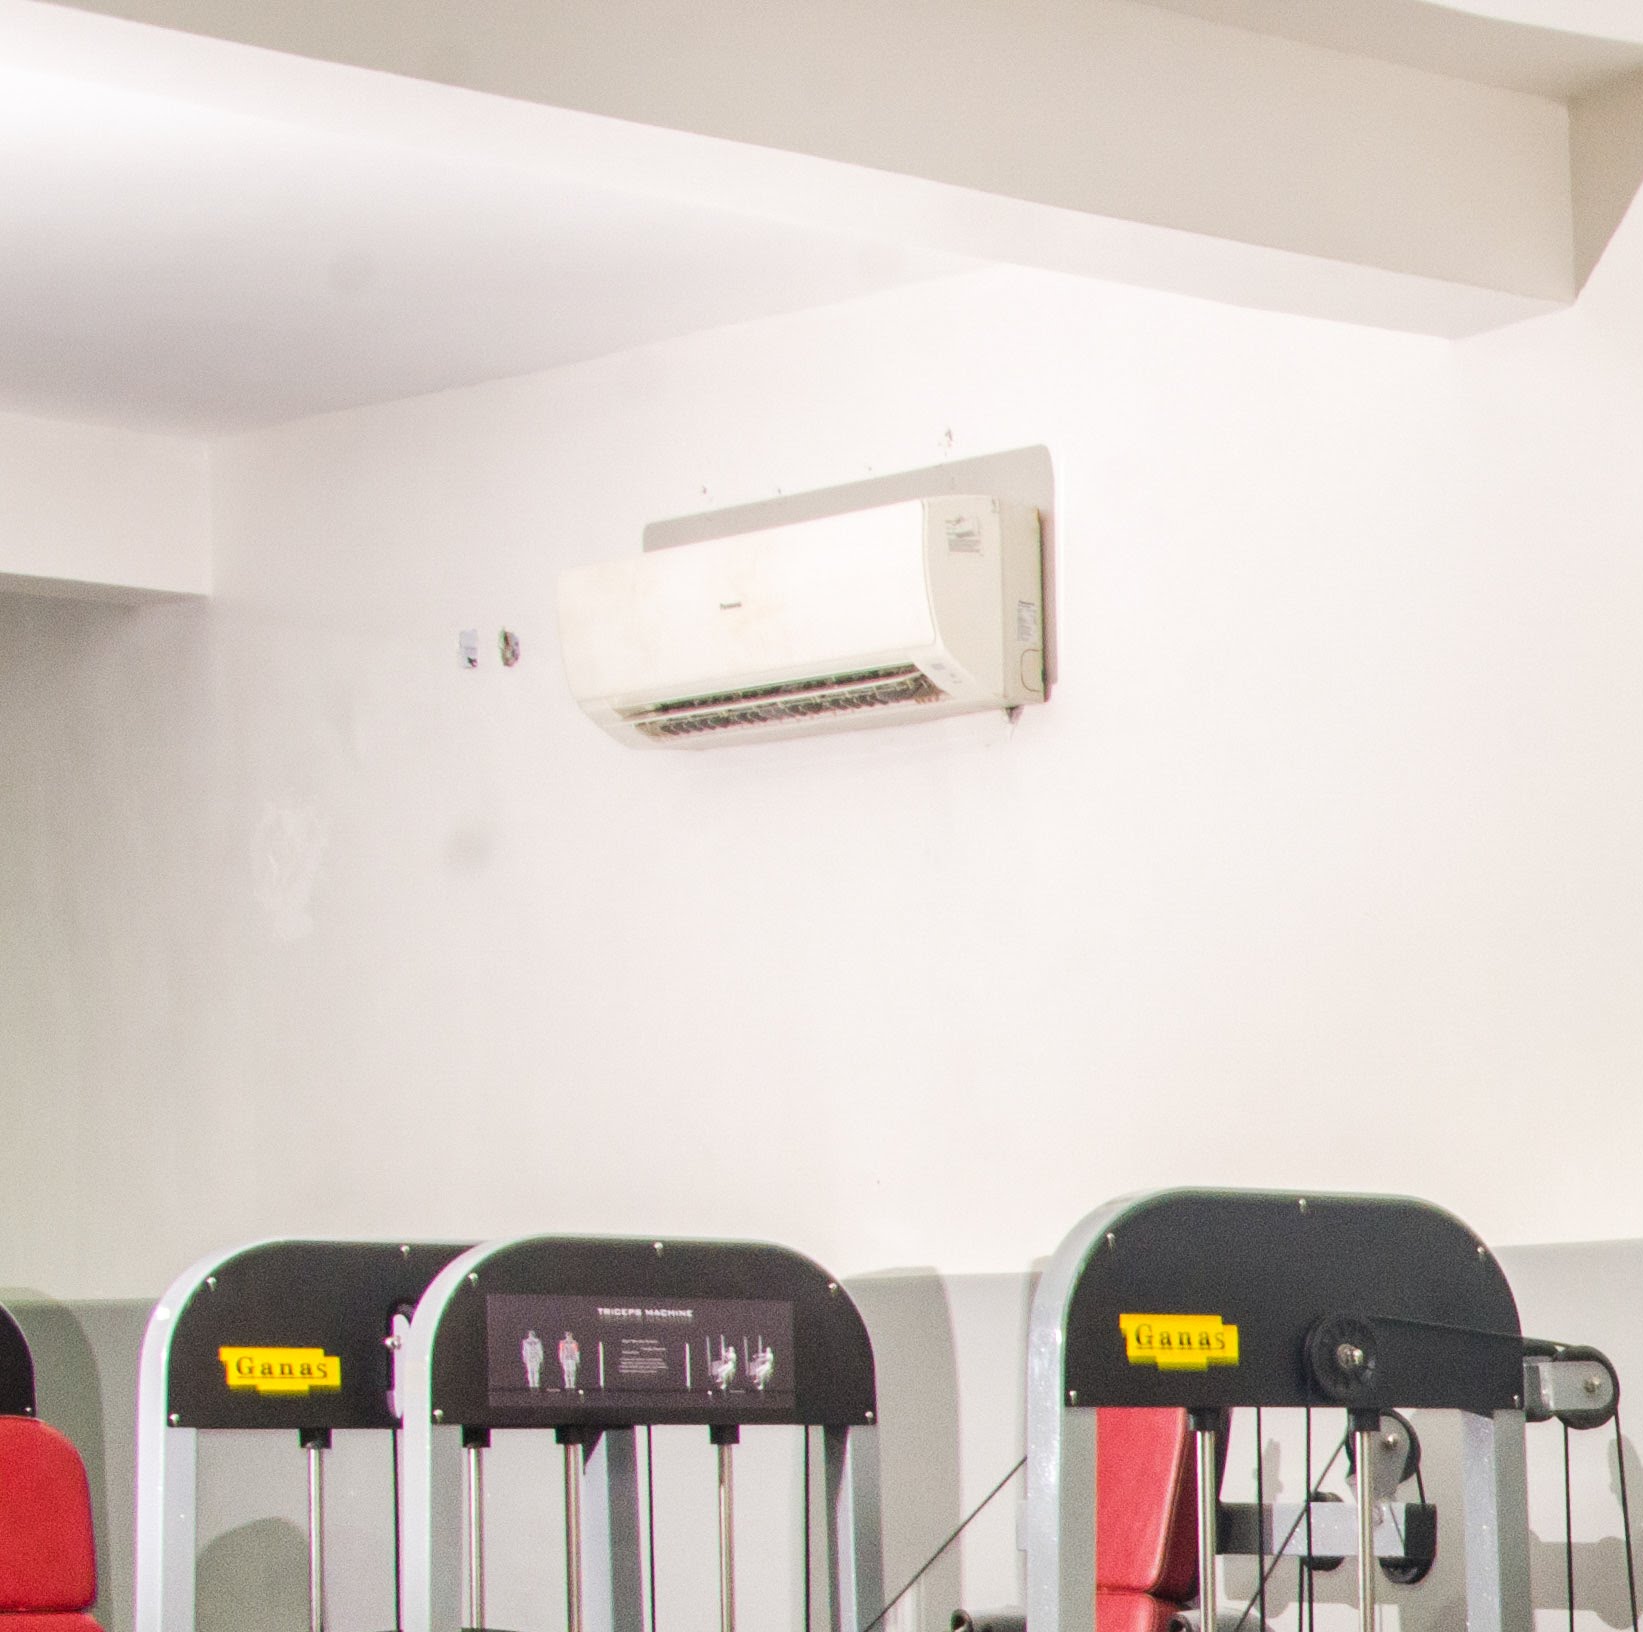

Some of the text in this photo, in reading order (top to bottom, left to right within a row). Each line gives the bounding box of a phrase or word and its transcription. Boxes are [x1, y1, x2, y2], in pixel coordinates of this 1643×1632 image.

[597, 1307, 693, 1318] TRICEPS MACHINE
[1135, 1323, 1226, 1350] Ganas
[236, 1356, 329, 1379] Ganas
